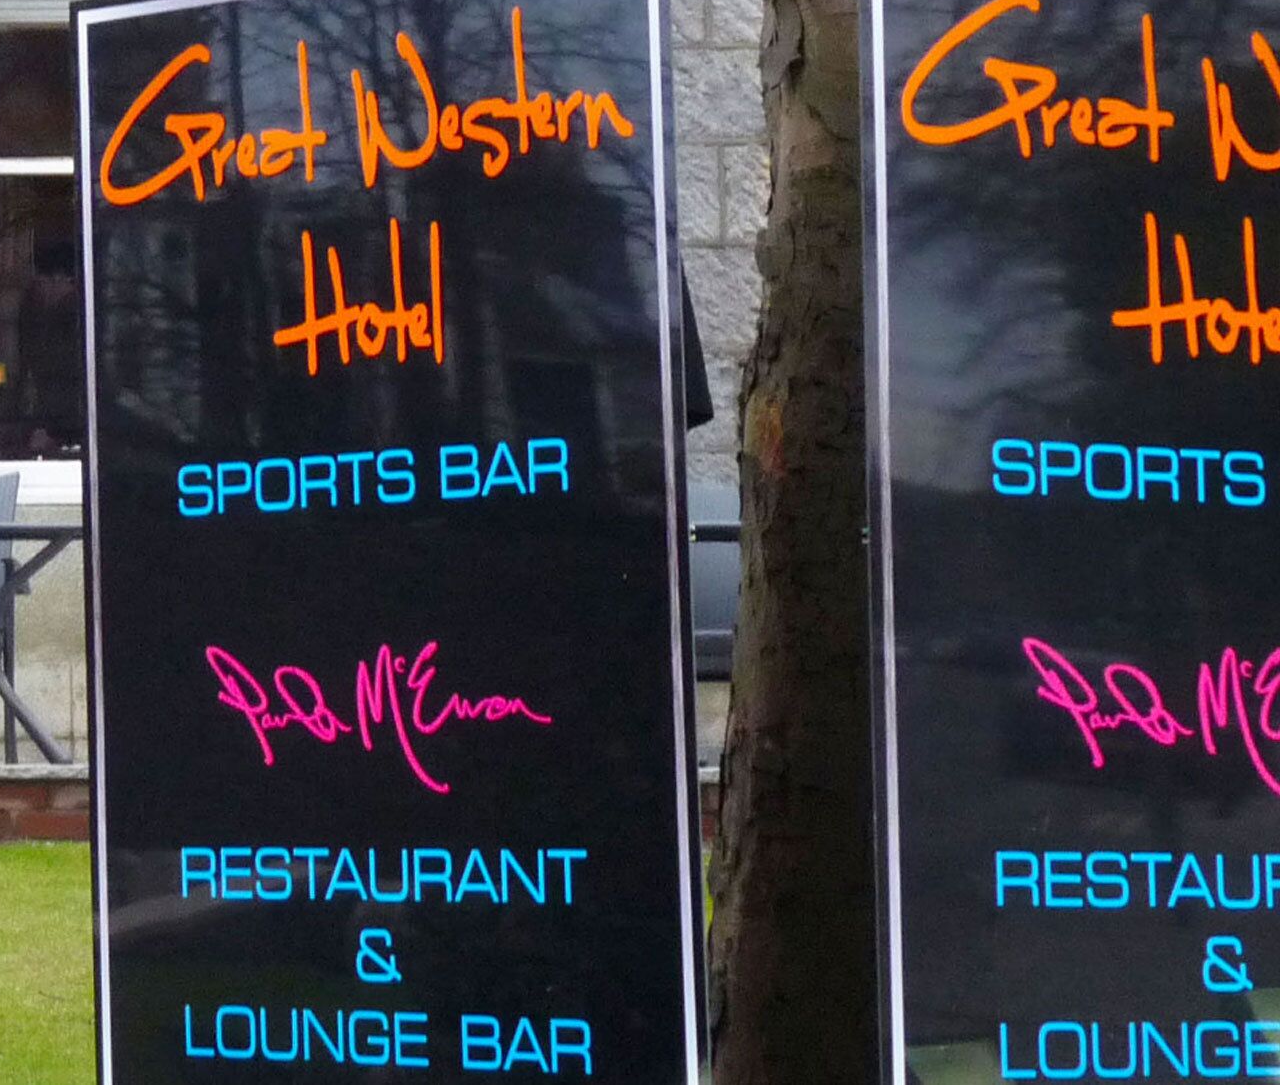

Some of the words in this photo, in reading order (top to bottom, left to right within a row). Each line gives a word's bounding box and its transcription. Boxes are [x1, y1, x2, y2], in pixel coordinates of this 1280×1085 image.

[99, 42, 327, 206] Great
[351, 6, 634, 188] Western
[272, 217, 444, 376] Hotel
[177, 448, 417, 518] SPORTS
[439, 437, 570, 500] BAR
[990, 438, 1267, 508] SPORTS
[180, 846, 588, 905] RESTAURANT
[355, 927, 402, 984] &
[1201, 934, 1254, 994] &
[184, 1003, 430, 1068] LOUNGE
[460, 1014, 593, 1076] BAR
[999, 1020, 1280, 1081] LOUNGE
